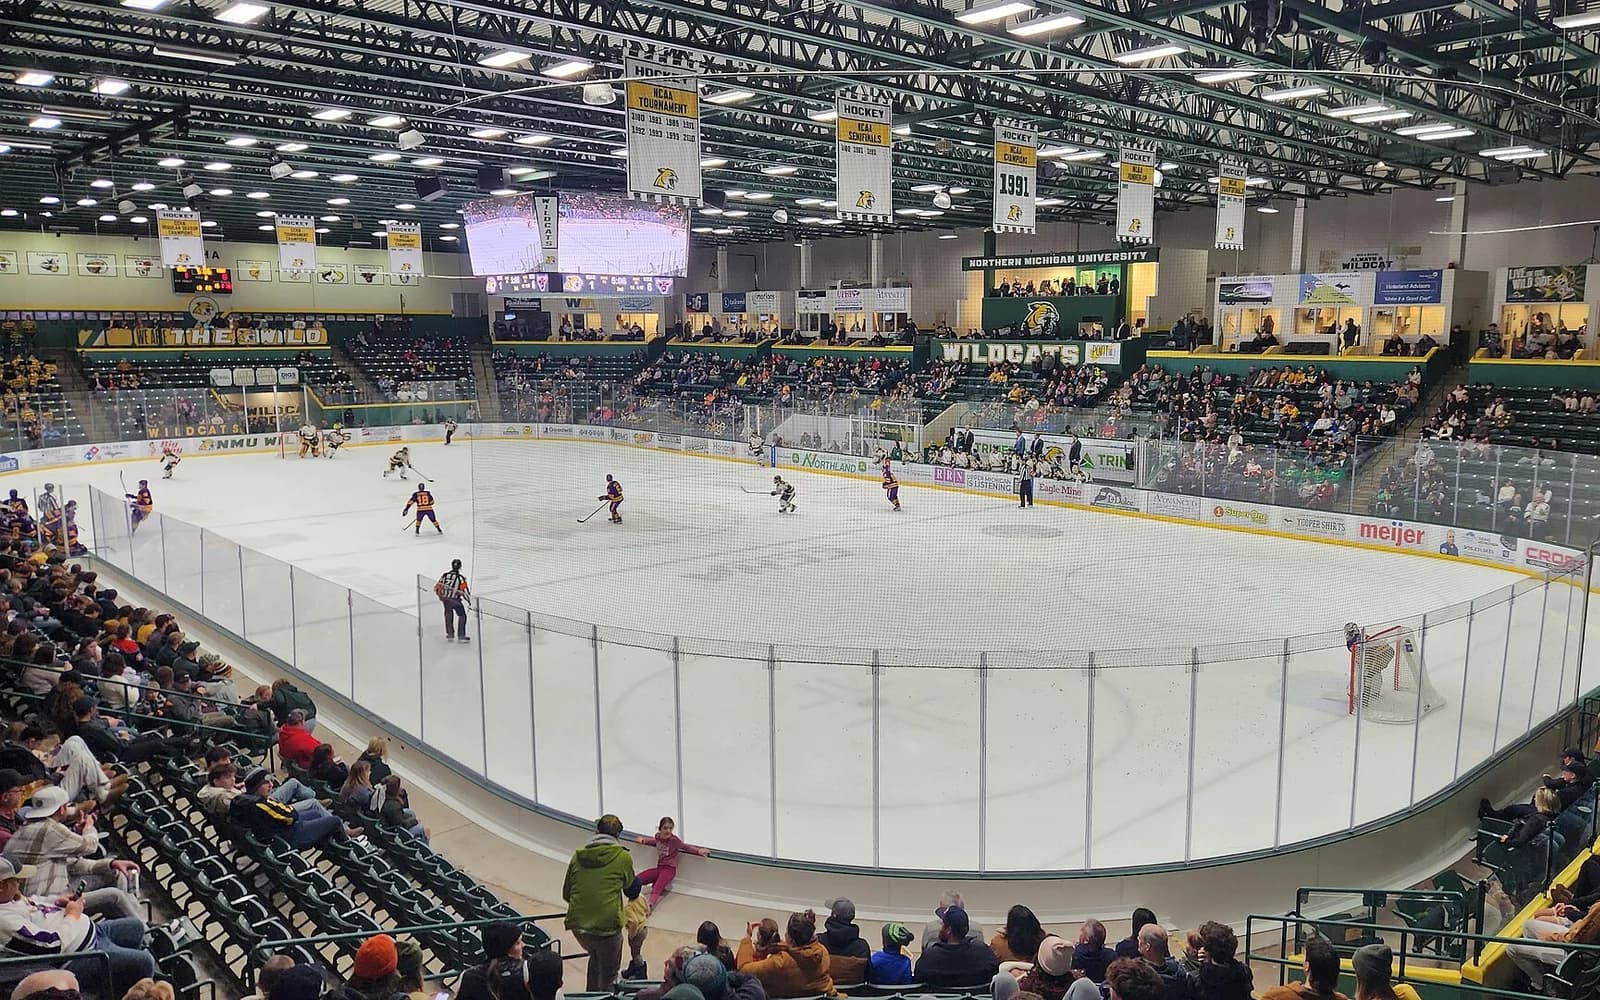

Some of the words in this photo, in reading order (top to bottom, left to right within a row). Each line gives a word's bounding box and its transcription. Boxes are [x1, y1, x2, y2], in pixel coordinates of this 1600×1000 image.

[653, 88, 673, 100] NCAA
[639, 97, 688, 114] TOURNAMENT
[844, 104, 884, 118] HOCKEY
[1002, 130, 1032, 142] HOCKEY
[1124, 152, 1151, 162] HOCKEY
[1222, 167, 1244, 177] HOCKEY
[999, 173, 1029, 197] 1991
[541, 198, 554, 247] WILDCATS
[969, 258, 1021, 268] NORTHERN
[1024, 255, 1075, 266] MICHIGAN
[1077, 251, 1148, 263] UNIVERSITY
[1342, 260, 1394, 270] WILDCAT
[1512, 277, 1534, 289] WILD
[1534, 275, 1553, 287] SIDE
[171, 329, 236, 344] THE
[257, 328, 322, 344] WILD
[940, 342, 1081, 366] WILDCATS
[148, 425, 239, 439] WILDCATS
[216, 438, 258, 449] NMU
[802, 452, 857, 473] NORTHLAND
[936, 469, 965, 483] RRN
[974, 481, 1012, 492] LISTENING
[1039, 483, 1060, 494] Eagle
[1061, 486, 1082, 497] Mine
[416, 495, 429, 506] 18
[1225, 506, 1249, 518] Super
[1250, 509, 1268, 520] One
[1297, 518, 1321, 529] YOOPER
[1321, 521, 1346, 532] SHIRTS
[1360, 521, 1425, 546] meijer
